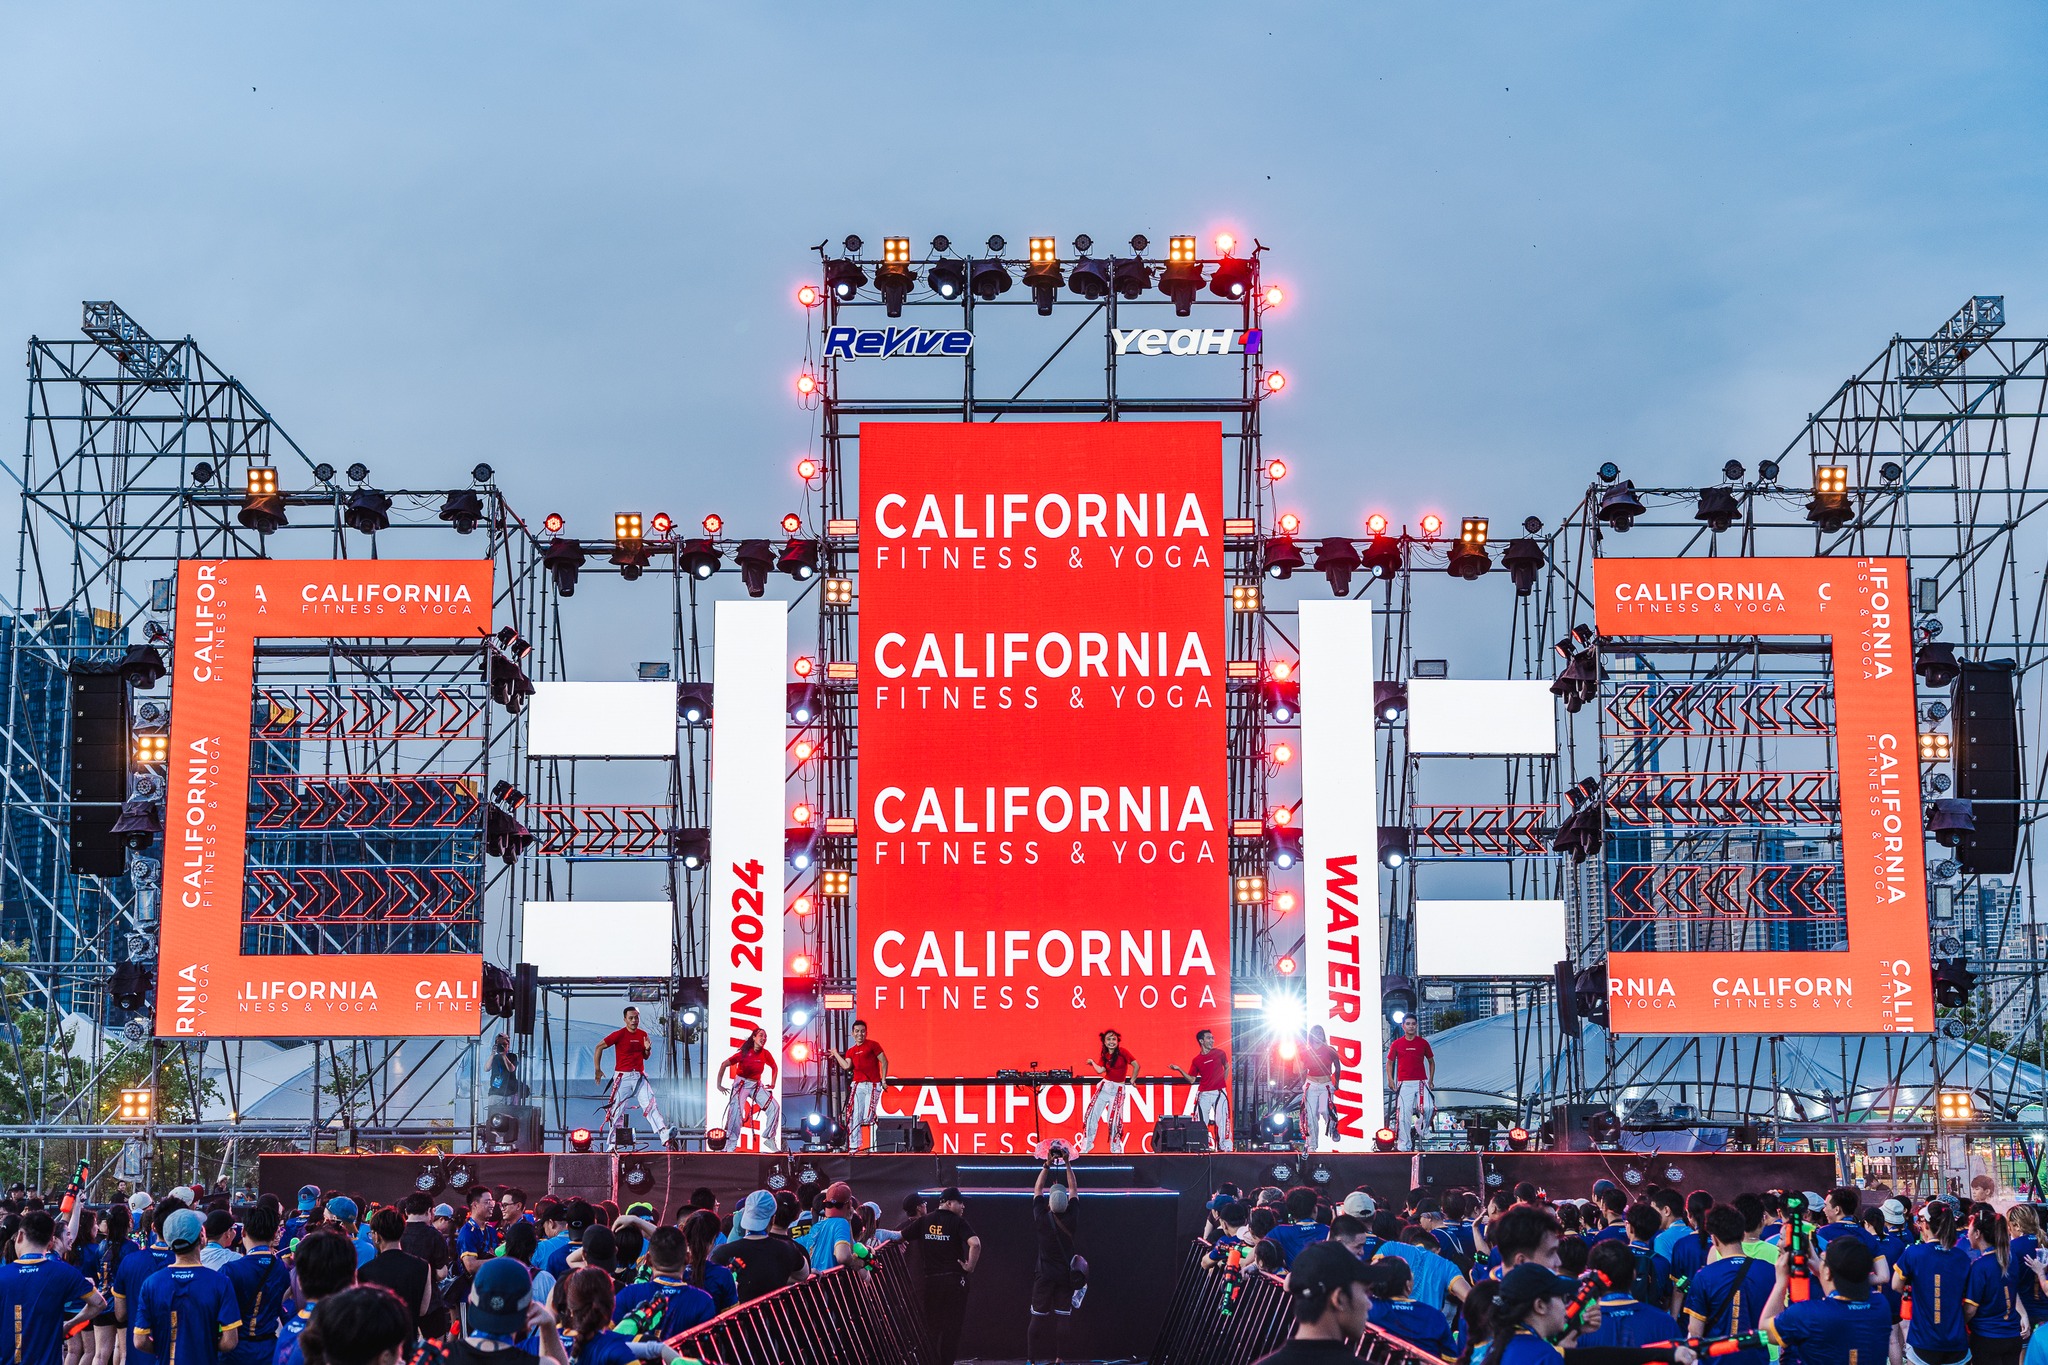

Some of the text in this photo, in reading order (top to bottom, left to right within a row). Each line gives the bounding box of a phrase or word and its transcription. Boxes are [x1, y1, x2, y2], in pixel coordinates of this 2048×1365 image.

[875, 492, 1210, 539] CALIFORNIA
[877, 545, 1210, 569] FITNESS & YOGA
[217, 577, 228, 586] &
[301, 583, 472, 603] CALIFORNIA
[1615, 582, 1785, 602] CALIFORNIA
[302, 604, 472, 614] FITNESS & YOGA
[1617, 602, 1786, 613] FITNESS & YOGA
[1859, 608, 1870, 617] &
[1869, 557, 1893, 680] IFORNIA
[193, 559, 217, 682] CALIFOR
[213, 600, 227, 681] FITNESS
[874, 631, 1212, 679] CALIFORNIA
[1861, 629, 1873, 680] YOGA
[876, 685, 1212, 709] FITNESS & YOGA
[203, 736, 221, 907] FITNESS & YOGA
[873, 785, 1214, 834] CALIFORNIA
[1867, 734, 1885, 905] FITNESS & YOGA
[1878, 733, 1906, 904] CALIFORNIA
[182, 737, 209, 908] CALIFORNIA
[876, 840, 1215, 865] FITNESS & YOGA
[730, 858, 764, 972] 2024
[1325, 854, 1361, 1023] WATER
[873, 929, 1216, 978] CALIFORNIA
[198, 964, 209, 1016] YOGA
[415, 980, 478, 1000] CALI
[875, 984, 1217, 1010] FITNESS & YOGA
[1712, 977, 1853, 997] CALIFORN
[304, 1002, 313, 1012] &
[325, 1001, 378, 1012] YOGA
[1624, 998, 1677, 1009] YOGA
[1713, 998, 1797, 1009] FITNESS
[1812, 998, 1821, 1009] &
[924, 1233, 951, 1241] SECURITY
[929, 1224, 943, 1235] GE
